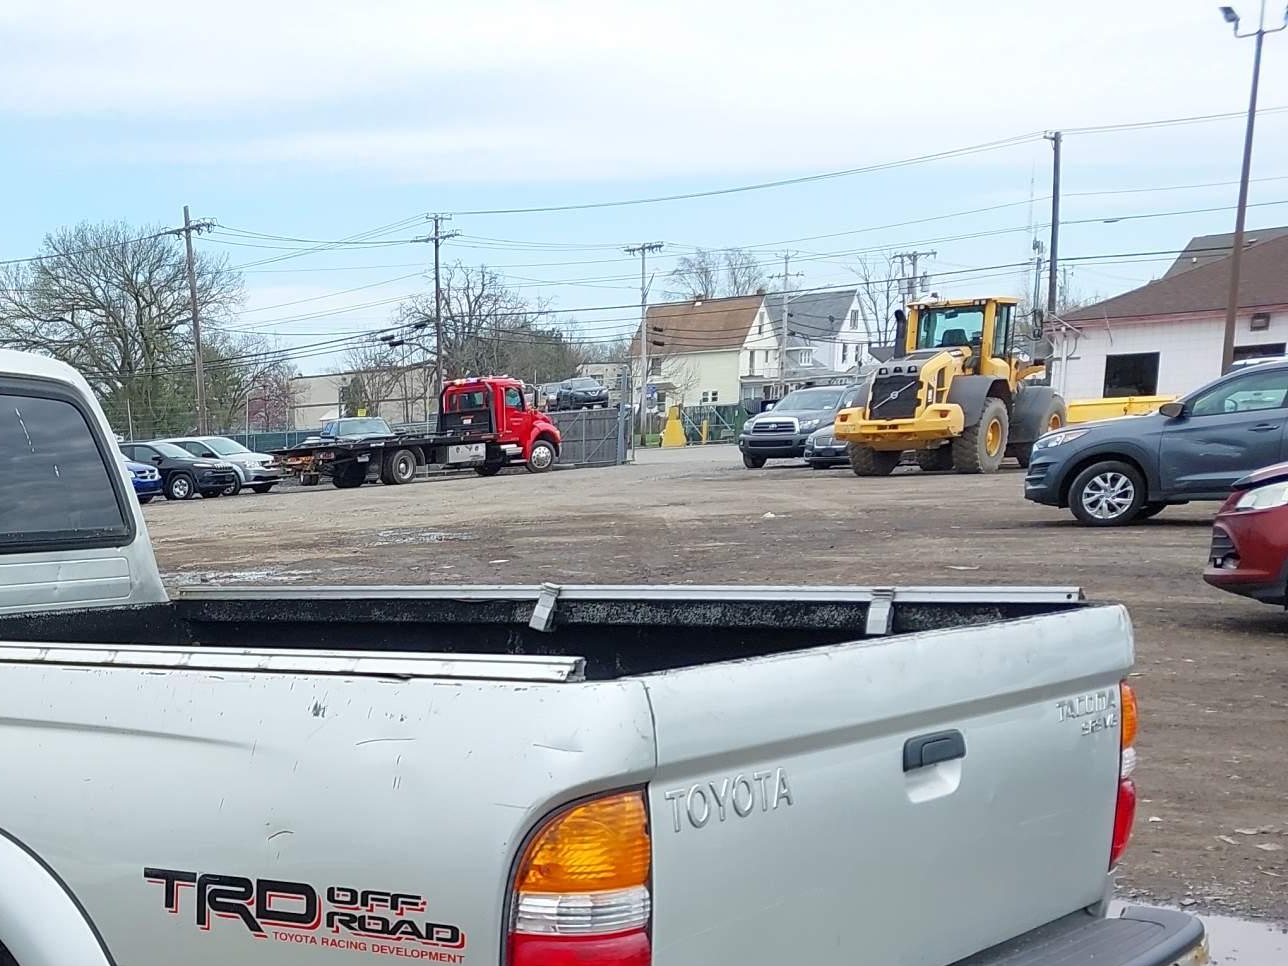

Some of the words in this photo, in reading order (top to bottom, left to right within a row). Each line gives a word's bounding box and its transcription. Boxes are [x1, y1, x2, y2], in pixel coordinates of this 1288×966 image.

[1055, 687, 1117, 723] TACOMA
[664, 767, 794, 833] TOYOTA
[143, 866, 322, 939] TRD
[325, 885, 427, 916] OFF
[271, 930, 318, 946] TOYOTA
[320, 936, 368, 953] RACING
[370, 943, 466, 965] DEVELOPMENT
[325, 911, 466, 949] ROAD
